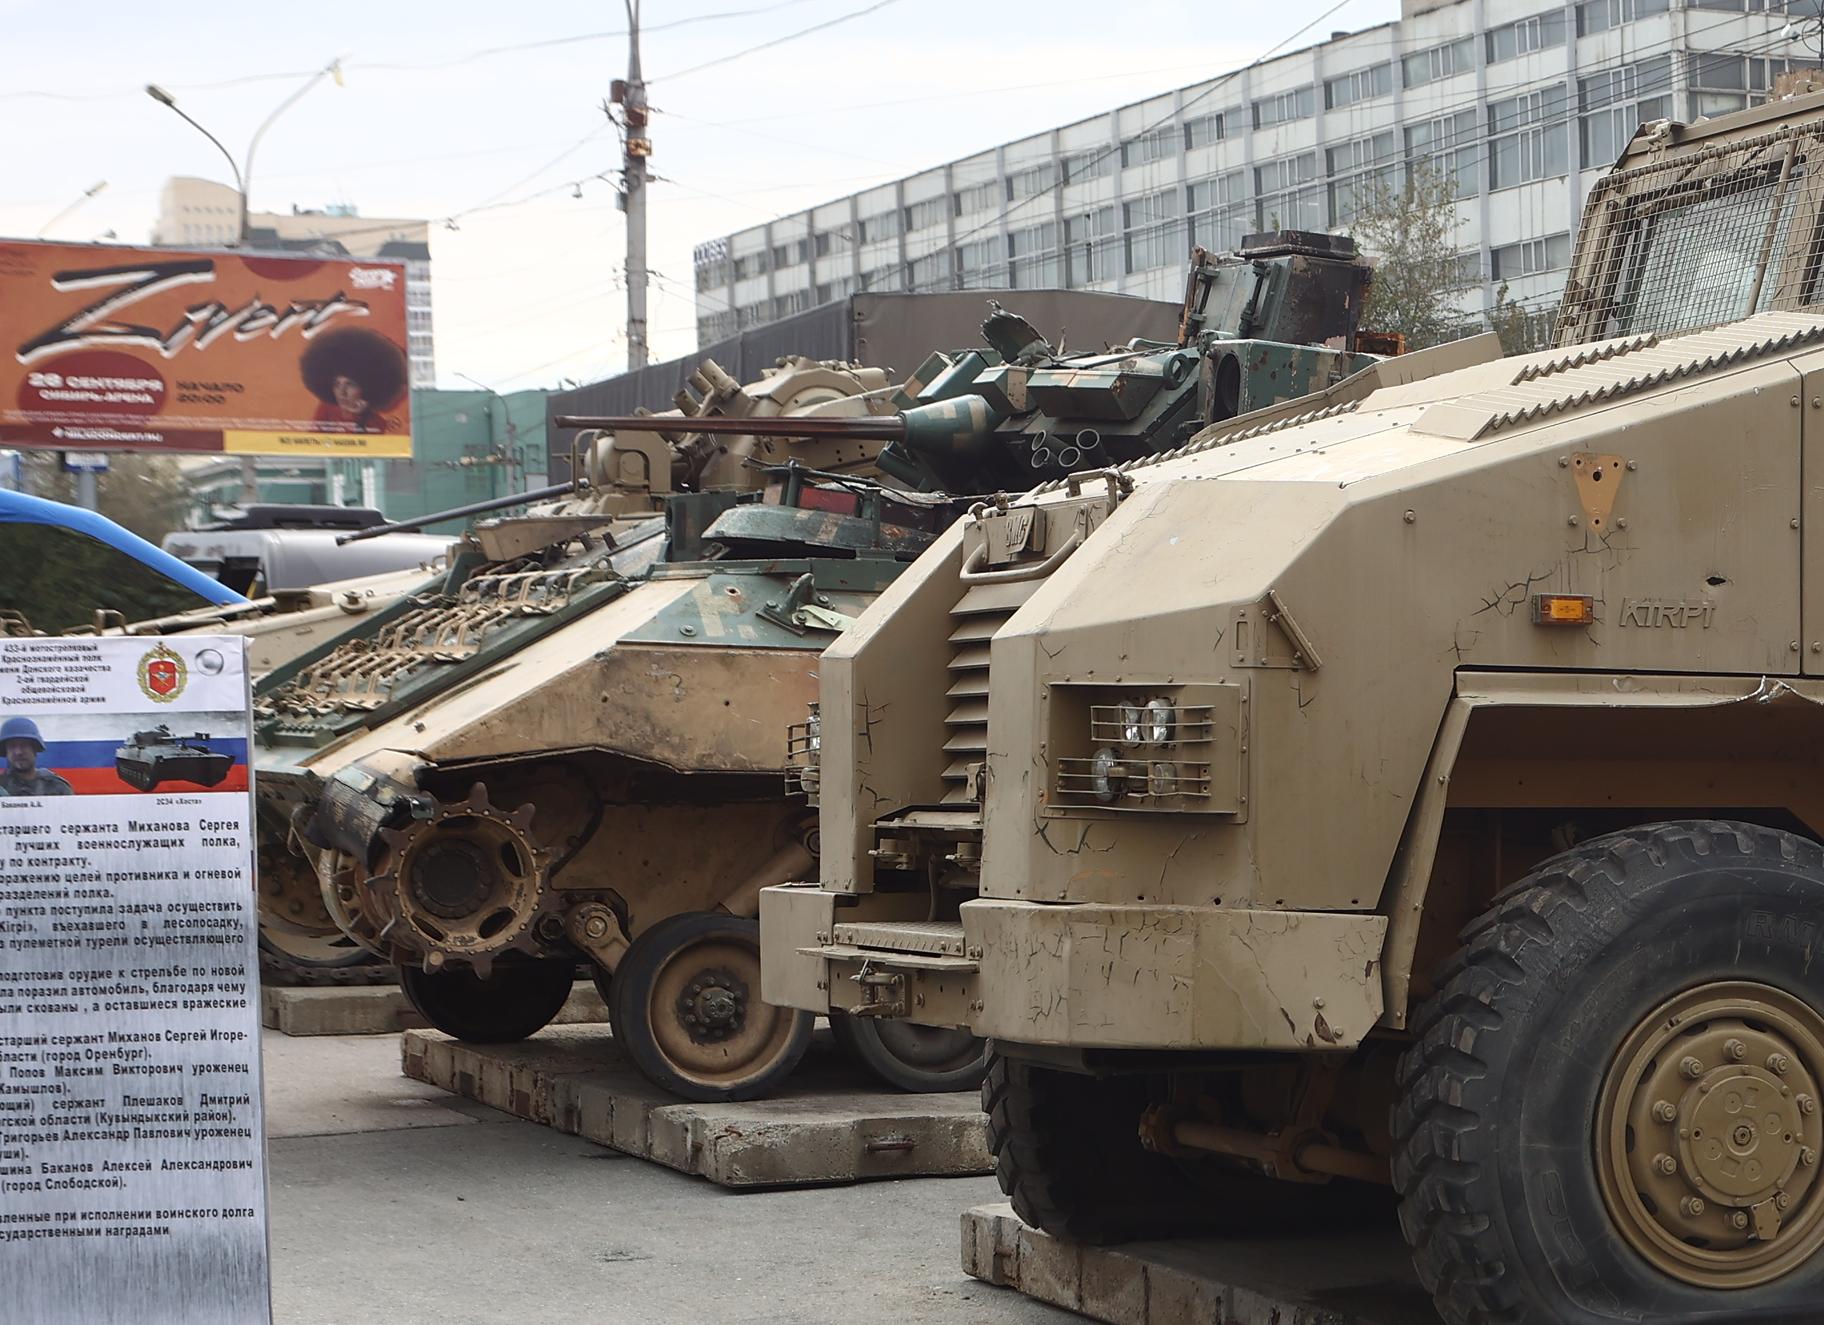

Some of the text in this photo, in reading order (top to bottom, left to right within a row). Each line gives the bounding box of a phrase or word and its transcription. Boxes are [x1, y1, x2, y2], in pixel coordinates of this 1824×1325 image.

[65, 375, 165, 392] СЕНТЯБРЯ
[60, 823, 119, 836] сержанта
[128, 820, 190, 832] Миханова
[199, 818, 240, 833] Сергея
[15, 837, 240, 854] лучших военнослужащих полка,
[10, 858, 23, 867] по
[27, 857, 92, 869] контракту.
[65, 870, 102, 884] целей
[105, 871, 179, 884] противника
[183, 871, 190, 879] и
[194, 867, 241, 879] огневой
[73, 888, 115, 898] полка.
[6, 902, 242, 919] пункта поступила задача осуществить
[52, 920, 126, 931] въехавшего
[141, 920, 148, 928] в
[163, 917, 244, 930] лесопосадку,
[9, 936, 81, 951] пулеметной
[85, 936, 129, 950] турели
[133, 934, 244, 948] осуществляющего
[68, 970, 113, 982] орудие
[118, 969, 126, 977] к
[130, 965, 187, 980] стрельбе
[192, 967, 206, 976] по
[211, 964, 245, 976] новой
[18, 987, 68, 1000] поразил
[71, 982, 149, 996] автомобиль,
[152, 982, 215, 995] благодаря
[217, 983, 246, 995] чему
[26, 1003, 79, 1013] скованы
[104, 1000, 178, 1011] оставшиеся
[182, 999, 247, 1011] вражеские
[51, 1035, 104, 1047] сержант
[108, 1031, 161, 1043] Миханов
[164, 1029, 207, 1044] Сергей
[210, 1029, 248, 1043] Игоре-
[41, 1050, 81, 1064] (город
[84, 1046, 152, 1061] Оренбург).
[10, 1063, 249, 1078] Попов Максим Викторович уроженец
[52, 1098, 106, 1111] сержант
[123, 1095, 184, 1107] Плешаков
[200, 1092, 250, 1108] Дмитрий
[40, 1114, 92, 1126] области
[95, 1110, 190, 1126] (Кувындыкский
[194, 1109, 236, 1124] район).
[62, 1129, 130, 1141] Александр
[134, 1127, 190, 1139] Павлович
[194, 1127, 251, 1140] уроженец
[41, 1162, 94, 1174] Баканов
[102, 1159, 152, 1172] Алексей
[161, 1158, 253, 1172] Александрович
[1, 1176, 127, 1194] (город Слободской).
[54, 1211, 77, 1224] при
[80, 1210, 152, 1221] исполнении
[156, 1208, 219, 1219] воинского
[221, 1207, 255, 1219] долга
[105, 1226, 169, 1239] наградами
